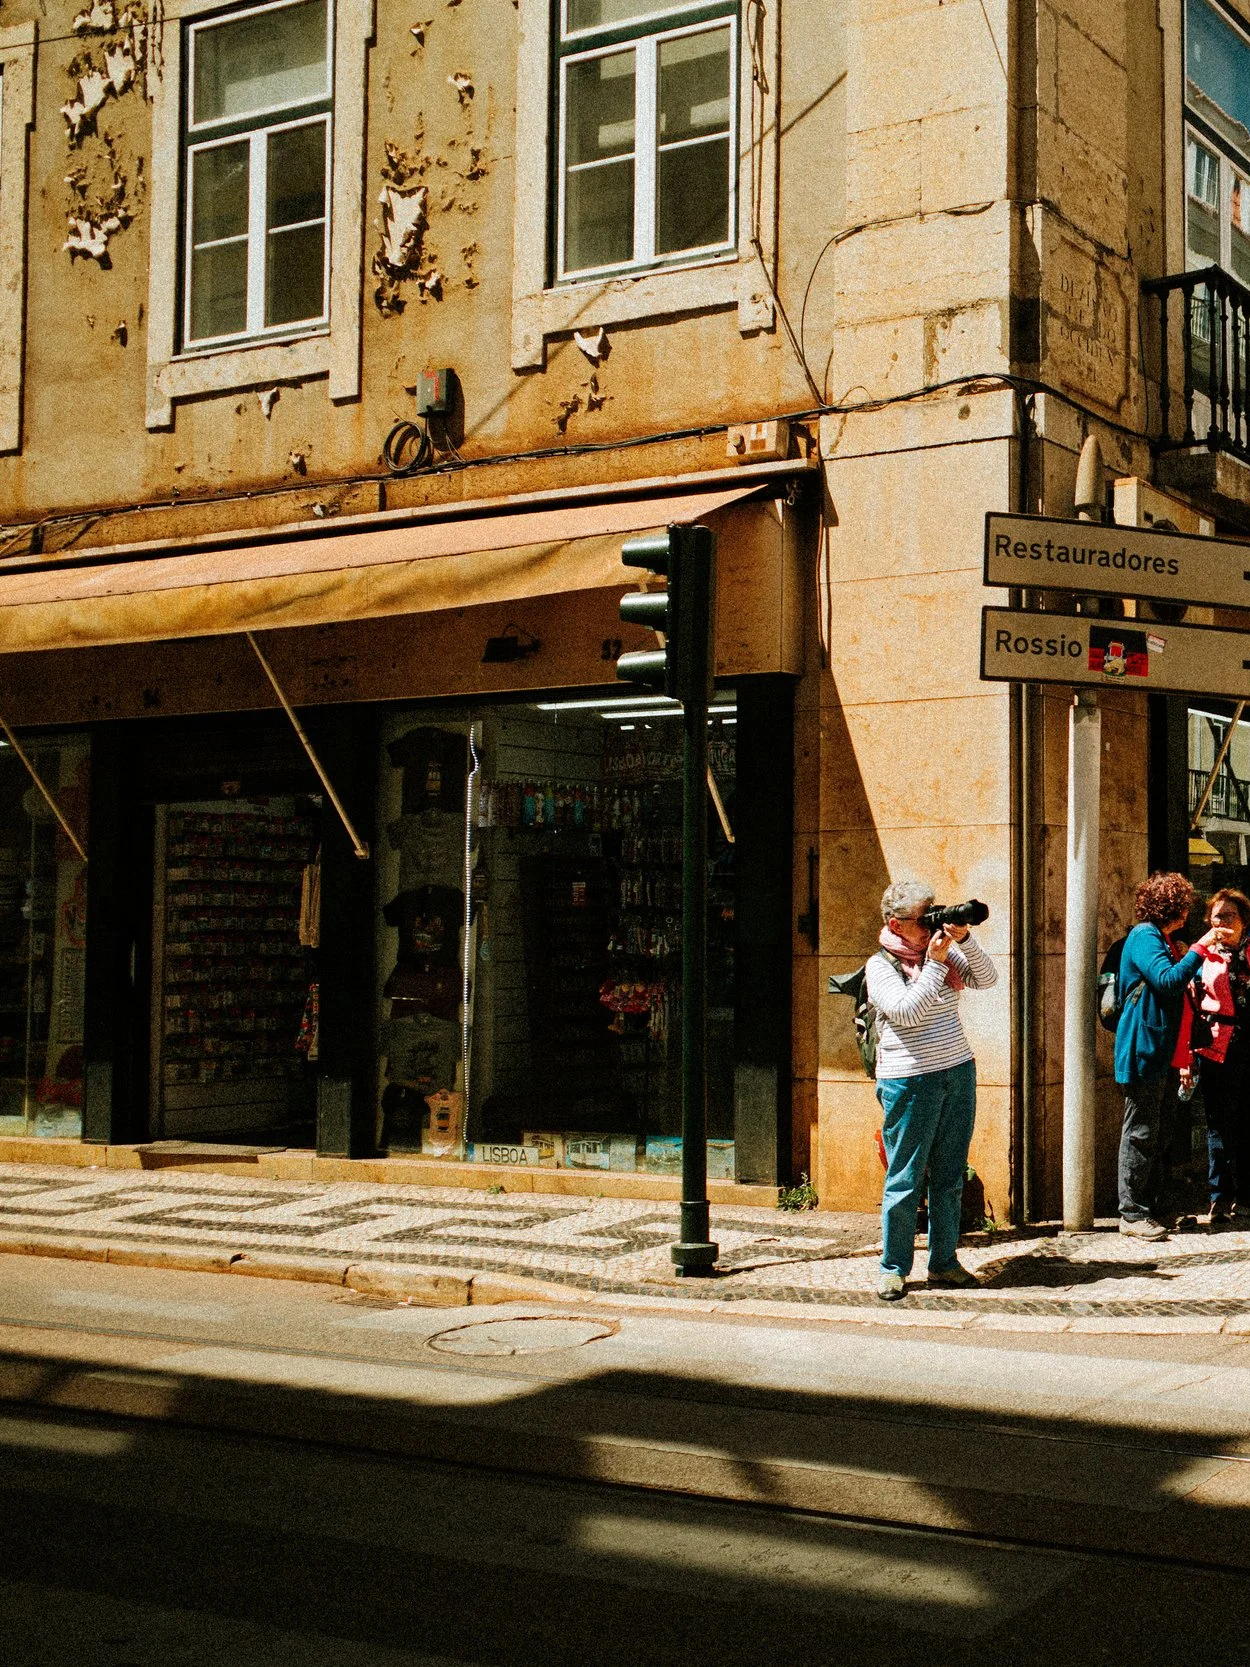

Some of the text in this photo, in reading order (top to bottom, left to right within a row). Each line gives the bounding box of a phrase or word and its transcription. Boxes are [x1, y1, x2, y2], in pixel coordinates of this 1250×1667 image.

[995, 534, 1179, 576] Restauradores
[995, 629, 1083, 658] Rossio
[482, 1145, 528, 1164] LISBOA
